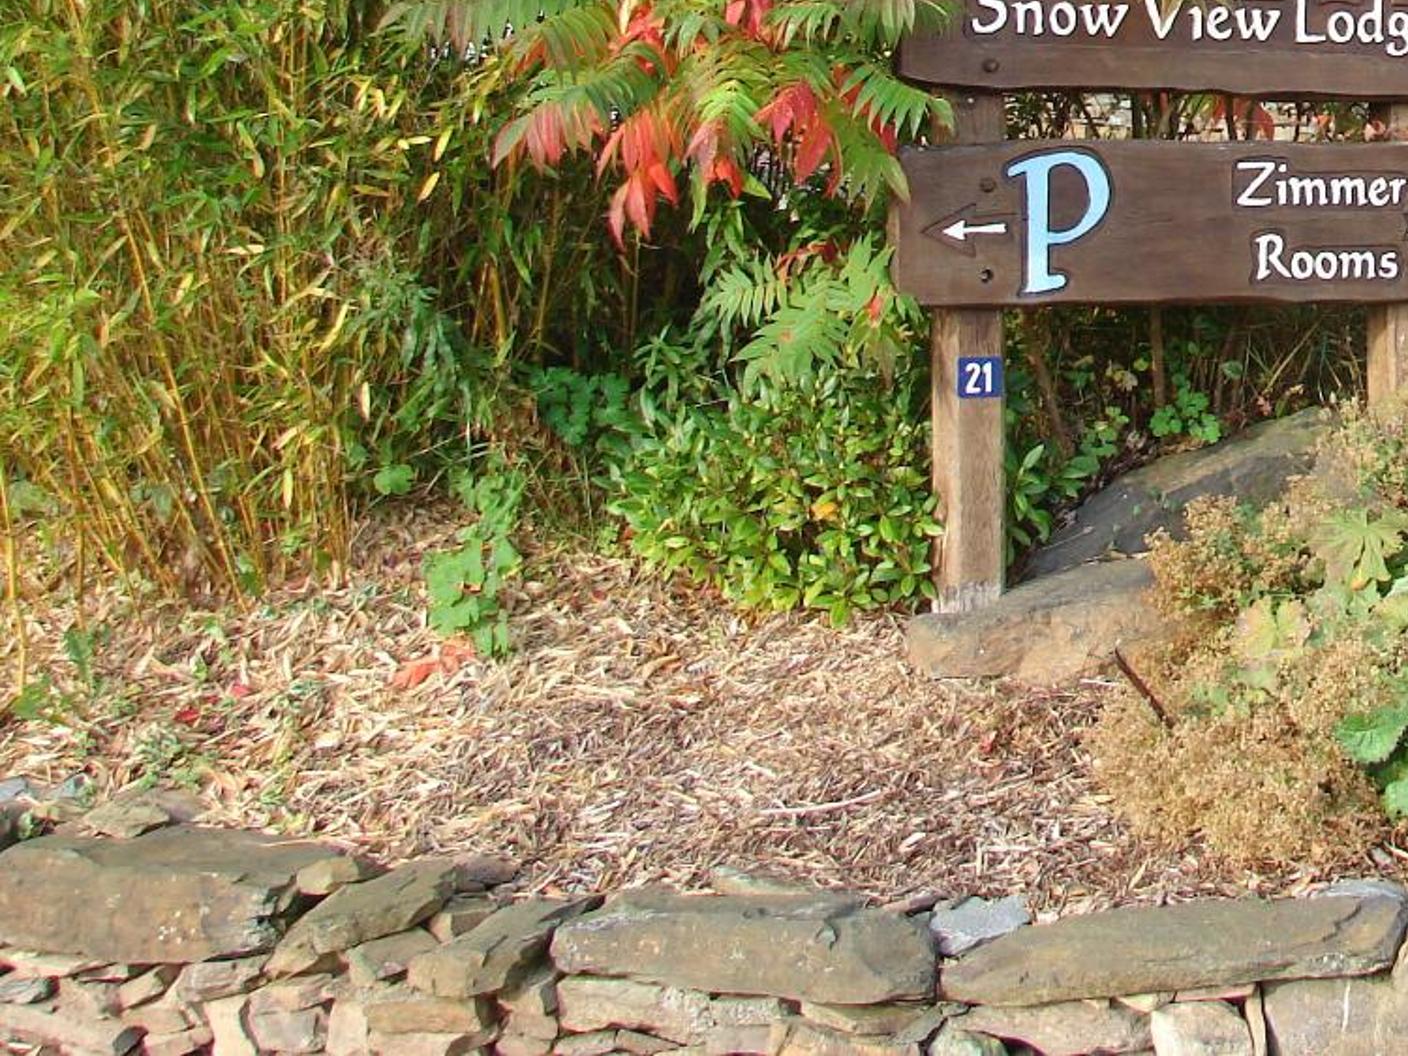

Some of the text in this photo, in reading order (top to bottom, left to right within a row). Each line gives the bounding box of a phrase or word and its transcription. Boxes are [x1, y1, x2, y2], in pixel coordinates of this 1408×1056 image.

[1236, 161, 1407, 207] Zimmer
[1006, 150, 1111, 294] P
[1254, 233, 1400, 280] Rooms
[965, 360, 992, 394] 21
